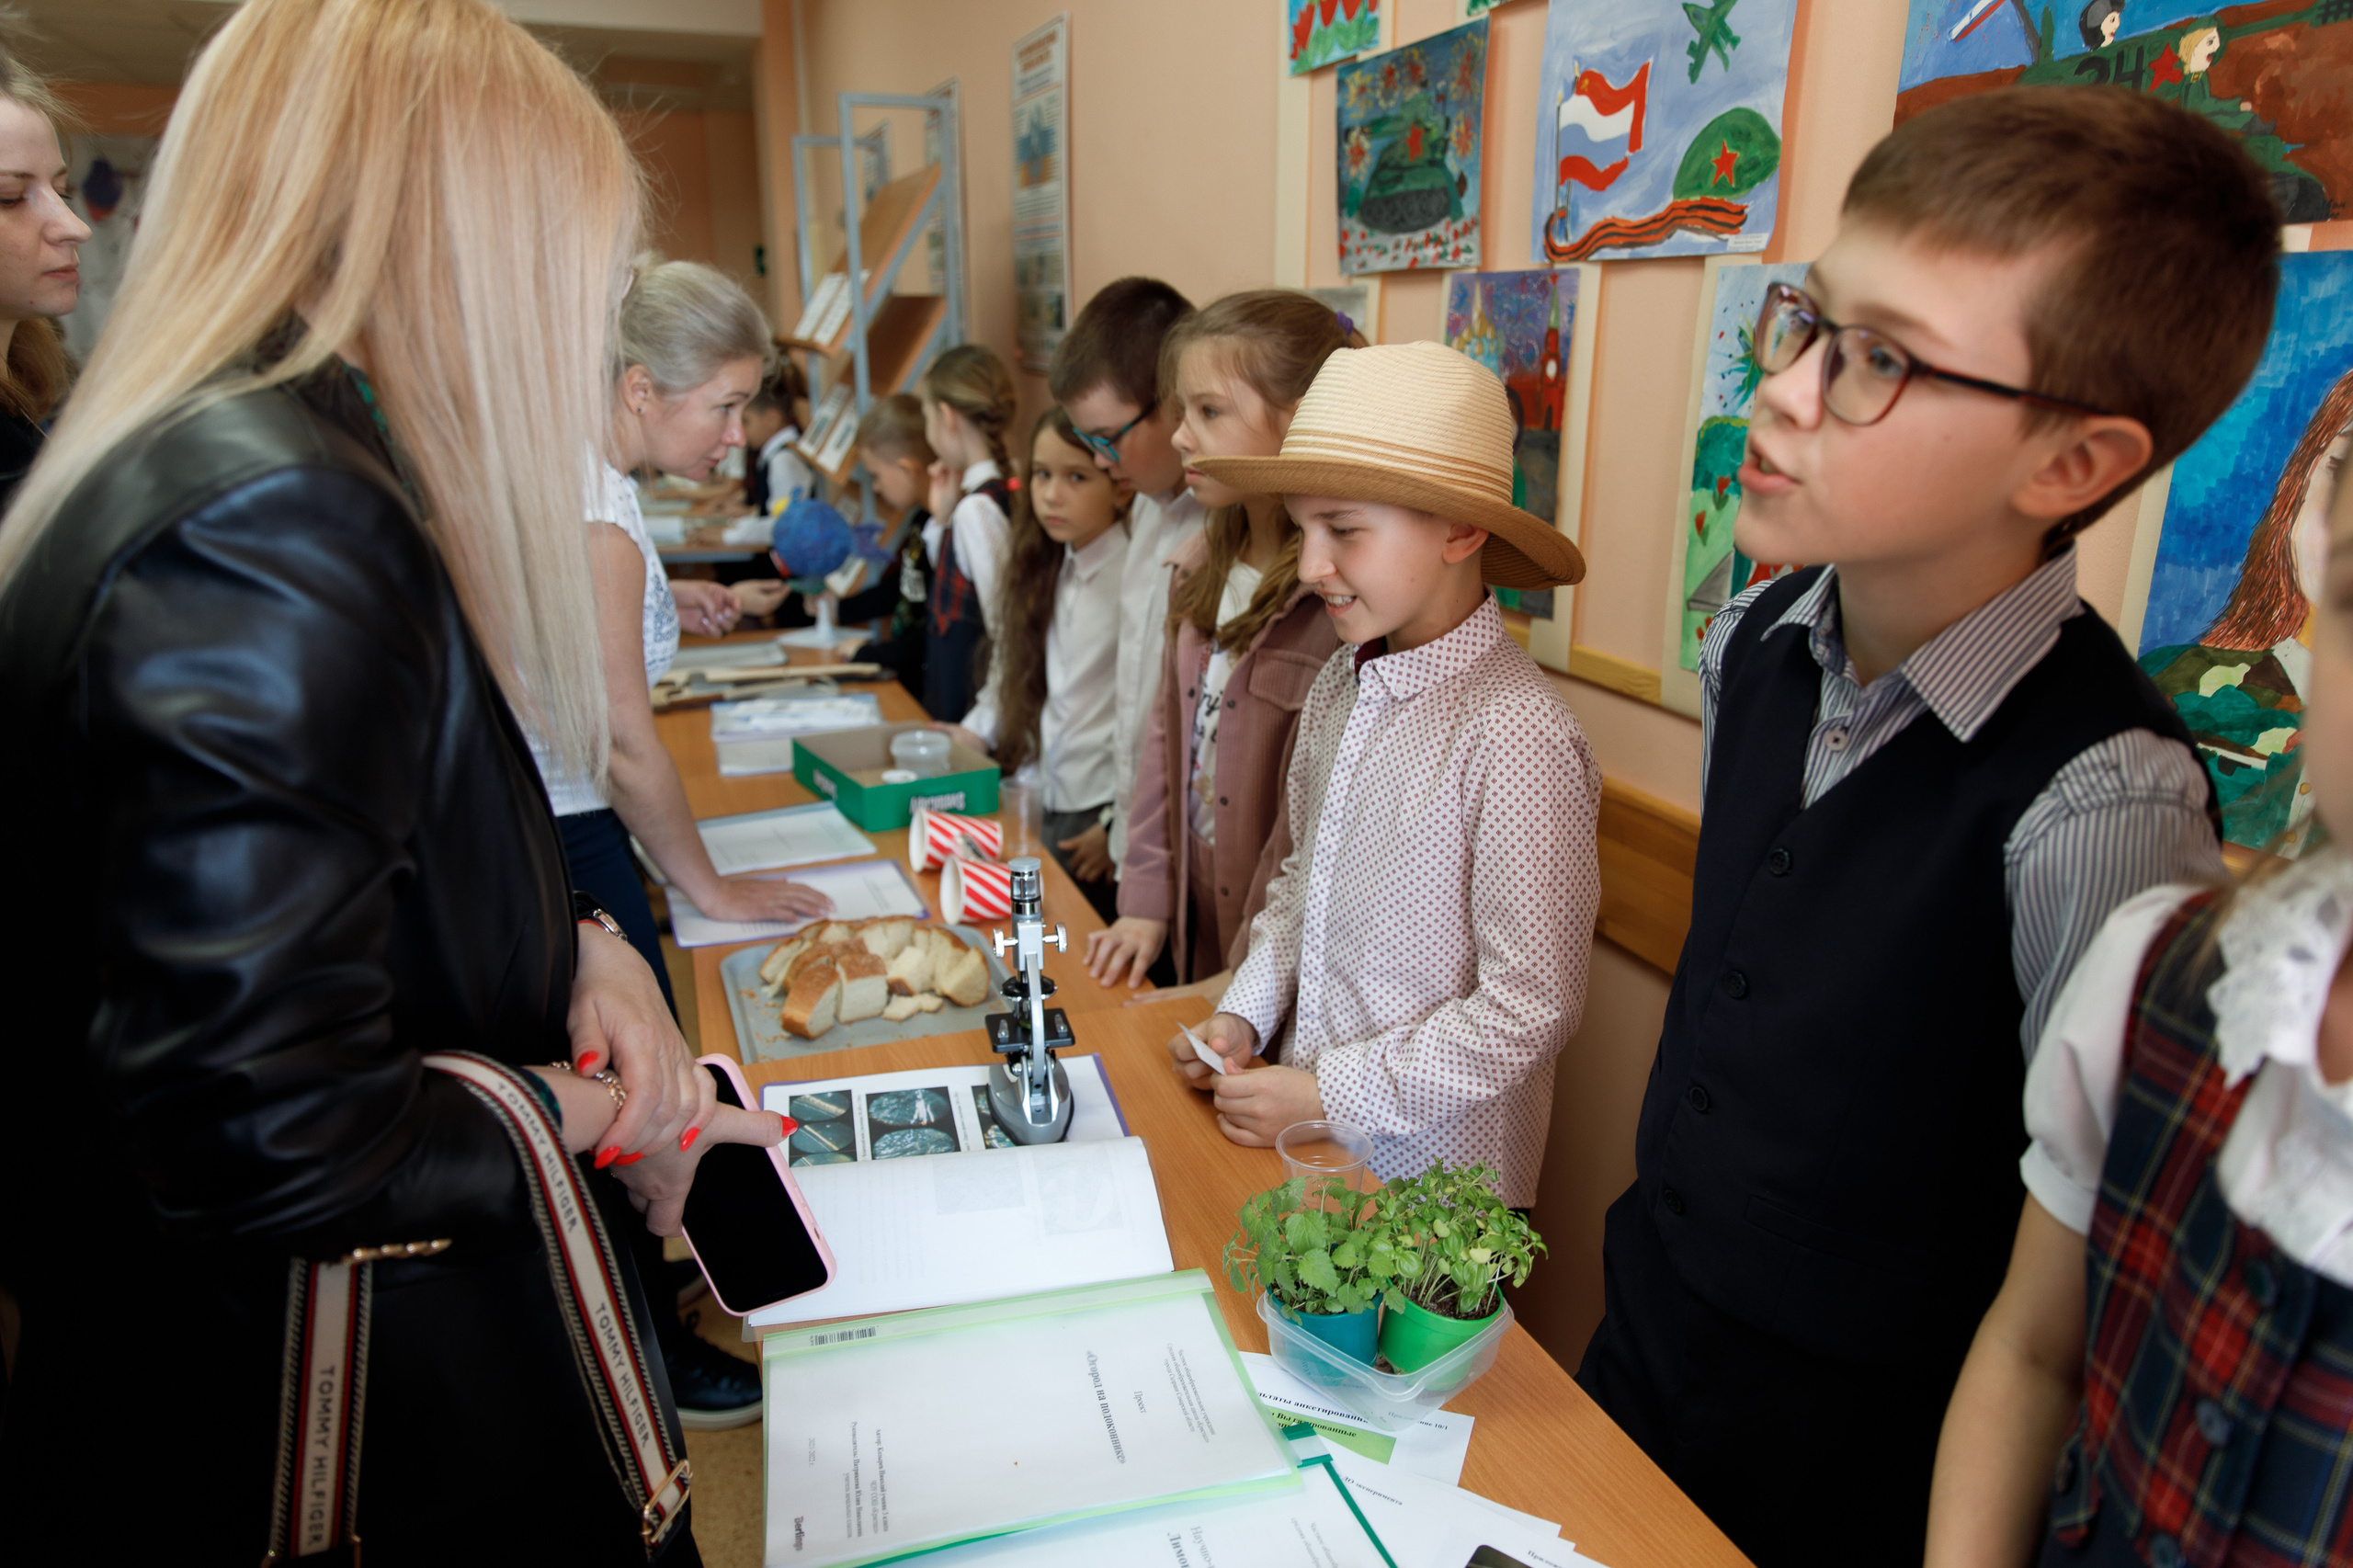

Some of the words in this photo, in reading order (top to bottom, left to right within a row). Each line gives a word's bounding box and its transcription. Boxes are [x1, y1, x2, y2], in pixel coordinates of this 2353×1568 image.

[497, 1081, 547, 1145] TOMMY
[544, 1151, 579, 1233] HILFIGER
[314, 1365, 335, 1449] TOMMY
[594, 1301, 625, 1369] TOMMY
[620, 1372, 651, 1449] HILFIGER
[1096, 1389, 1107, 1402] на
[1133, 1390, 1147, 1415] Проект
[1099, 1403, 1127, 1464] подоконнике»
[307, 1456, 327, 1547] HILFIGER
[793, 1516, 805, 1551] Berlingo
